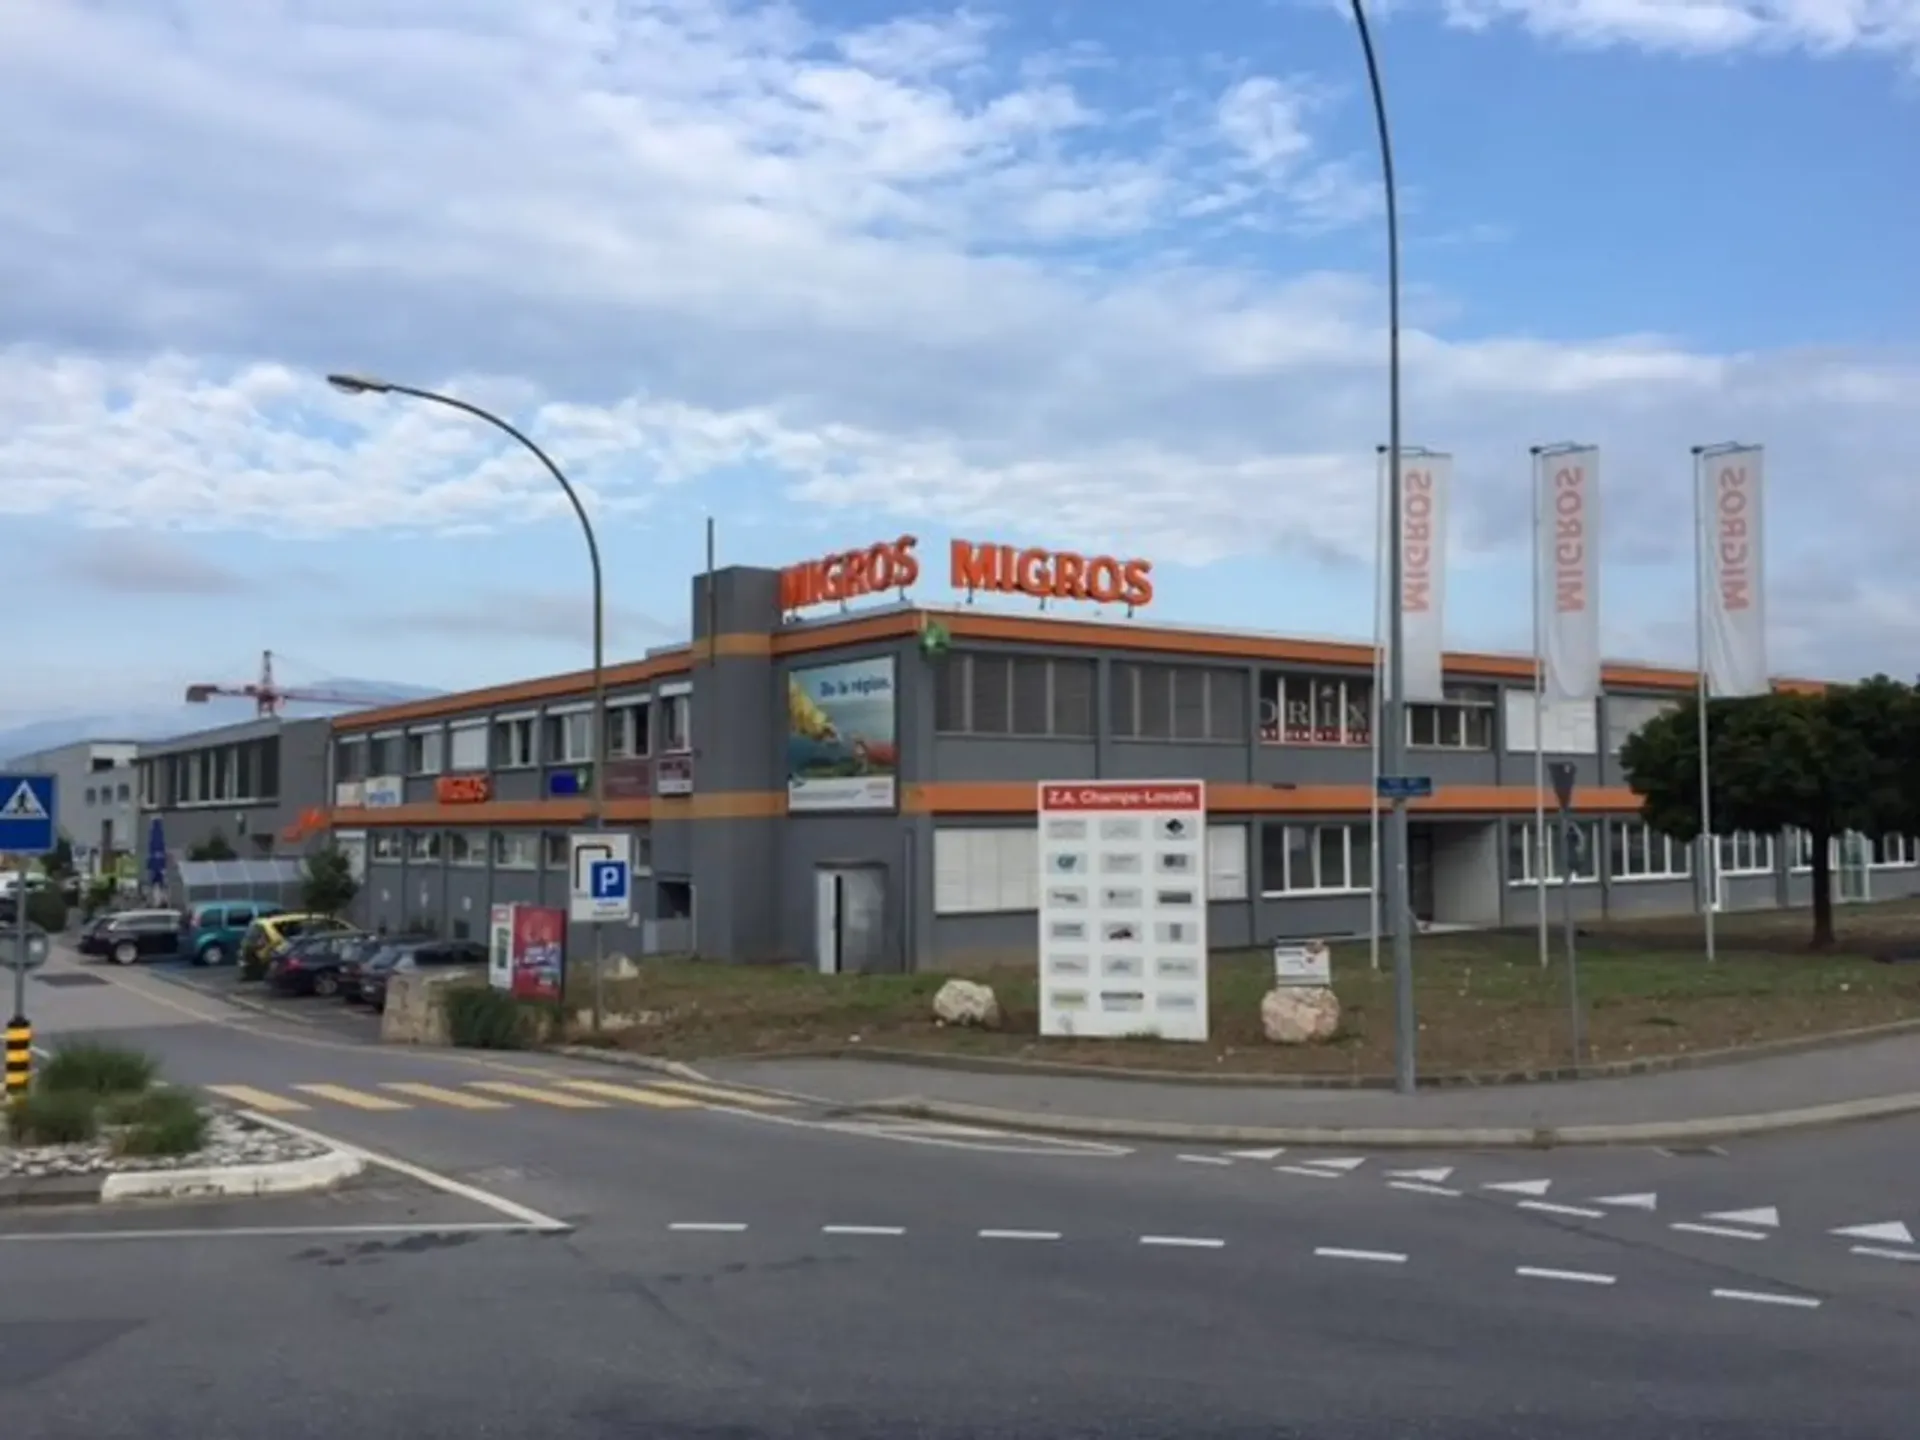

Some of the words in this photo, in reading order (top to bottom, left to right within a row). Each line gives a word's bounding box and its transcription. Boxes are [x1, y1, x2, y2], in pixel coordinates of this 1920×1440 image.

[780, 534, 918, 609] MIGROS
[951, 539, 1153, 606] MIGROS
[600, 866, 619, 894] P
